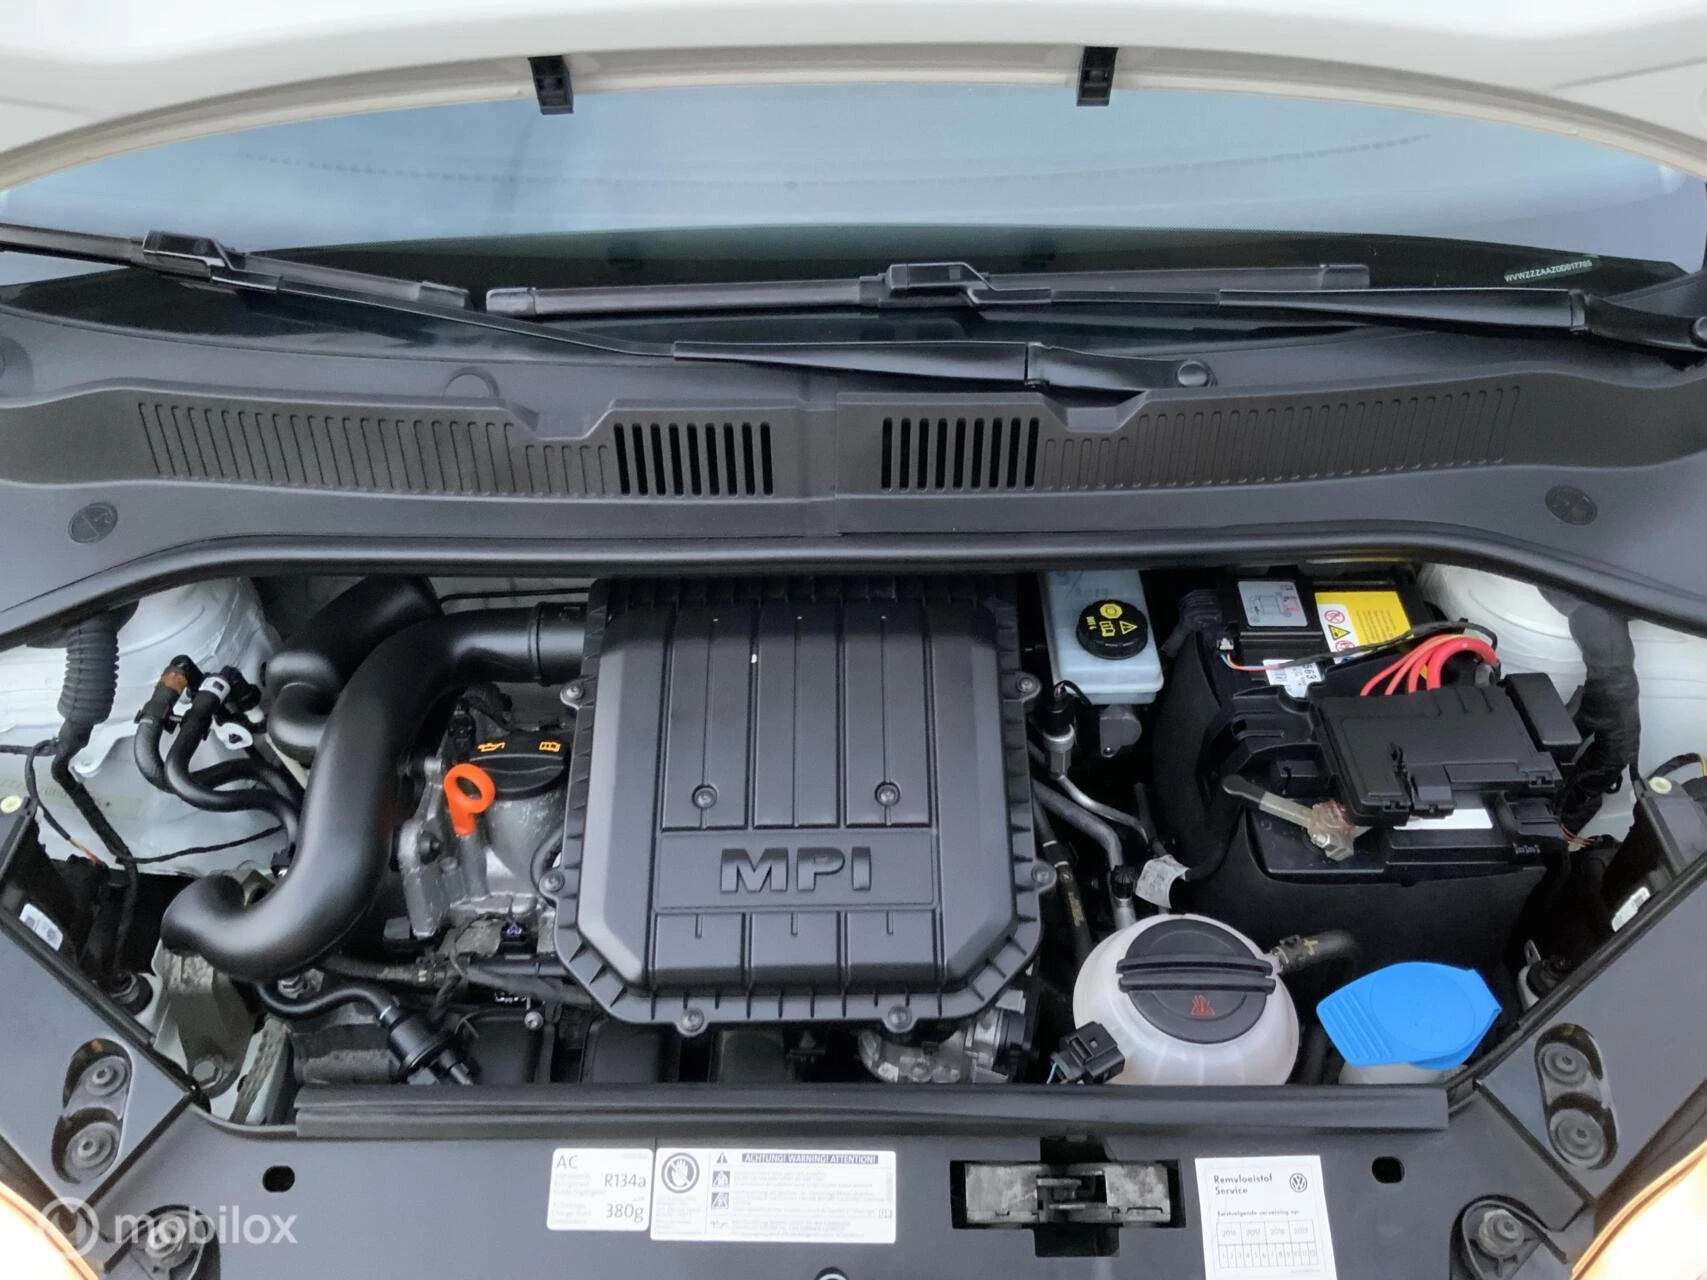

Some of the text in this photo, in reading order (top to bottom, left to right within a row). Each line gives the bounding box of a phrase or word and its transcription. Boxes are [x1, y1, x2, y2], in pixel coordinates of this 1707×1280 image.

[720, 846, 872, 894] MPI
[556, 1154, 579, 1169] AC
[787, 1154, 828, 1164] WARNING!
[829, 1155, 878, 1165] ATTENTION!
[604, 1173, 647, 1188] R134a
[1215, 1186, 1248, 1196] Service
[605, 1203, 645, 1224] 380g
